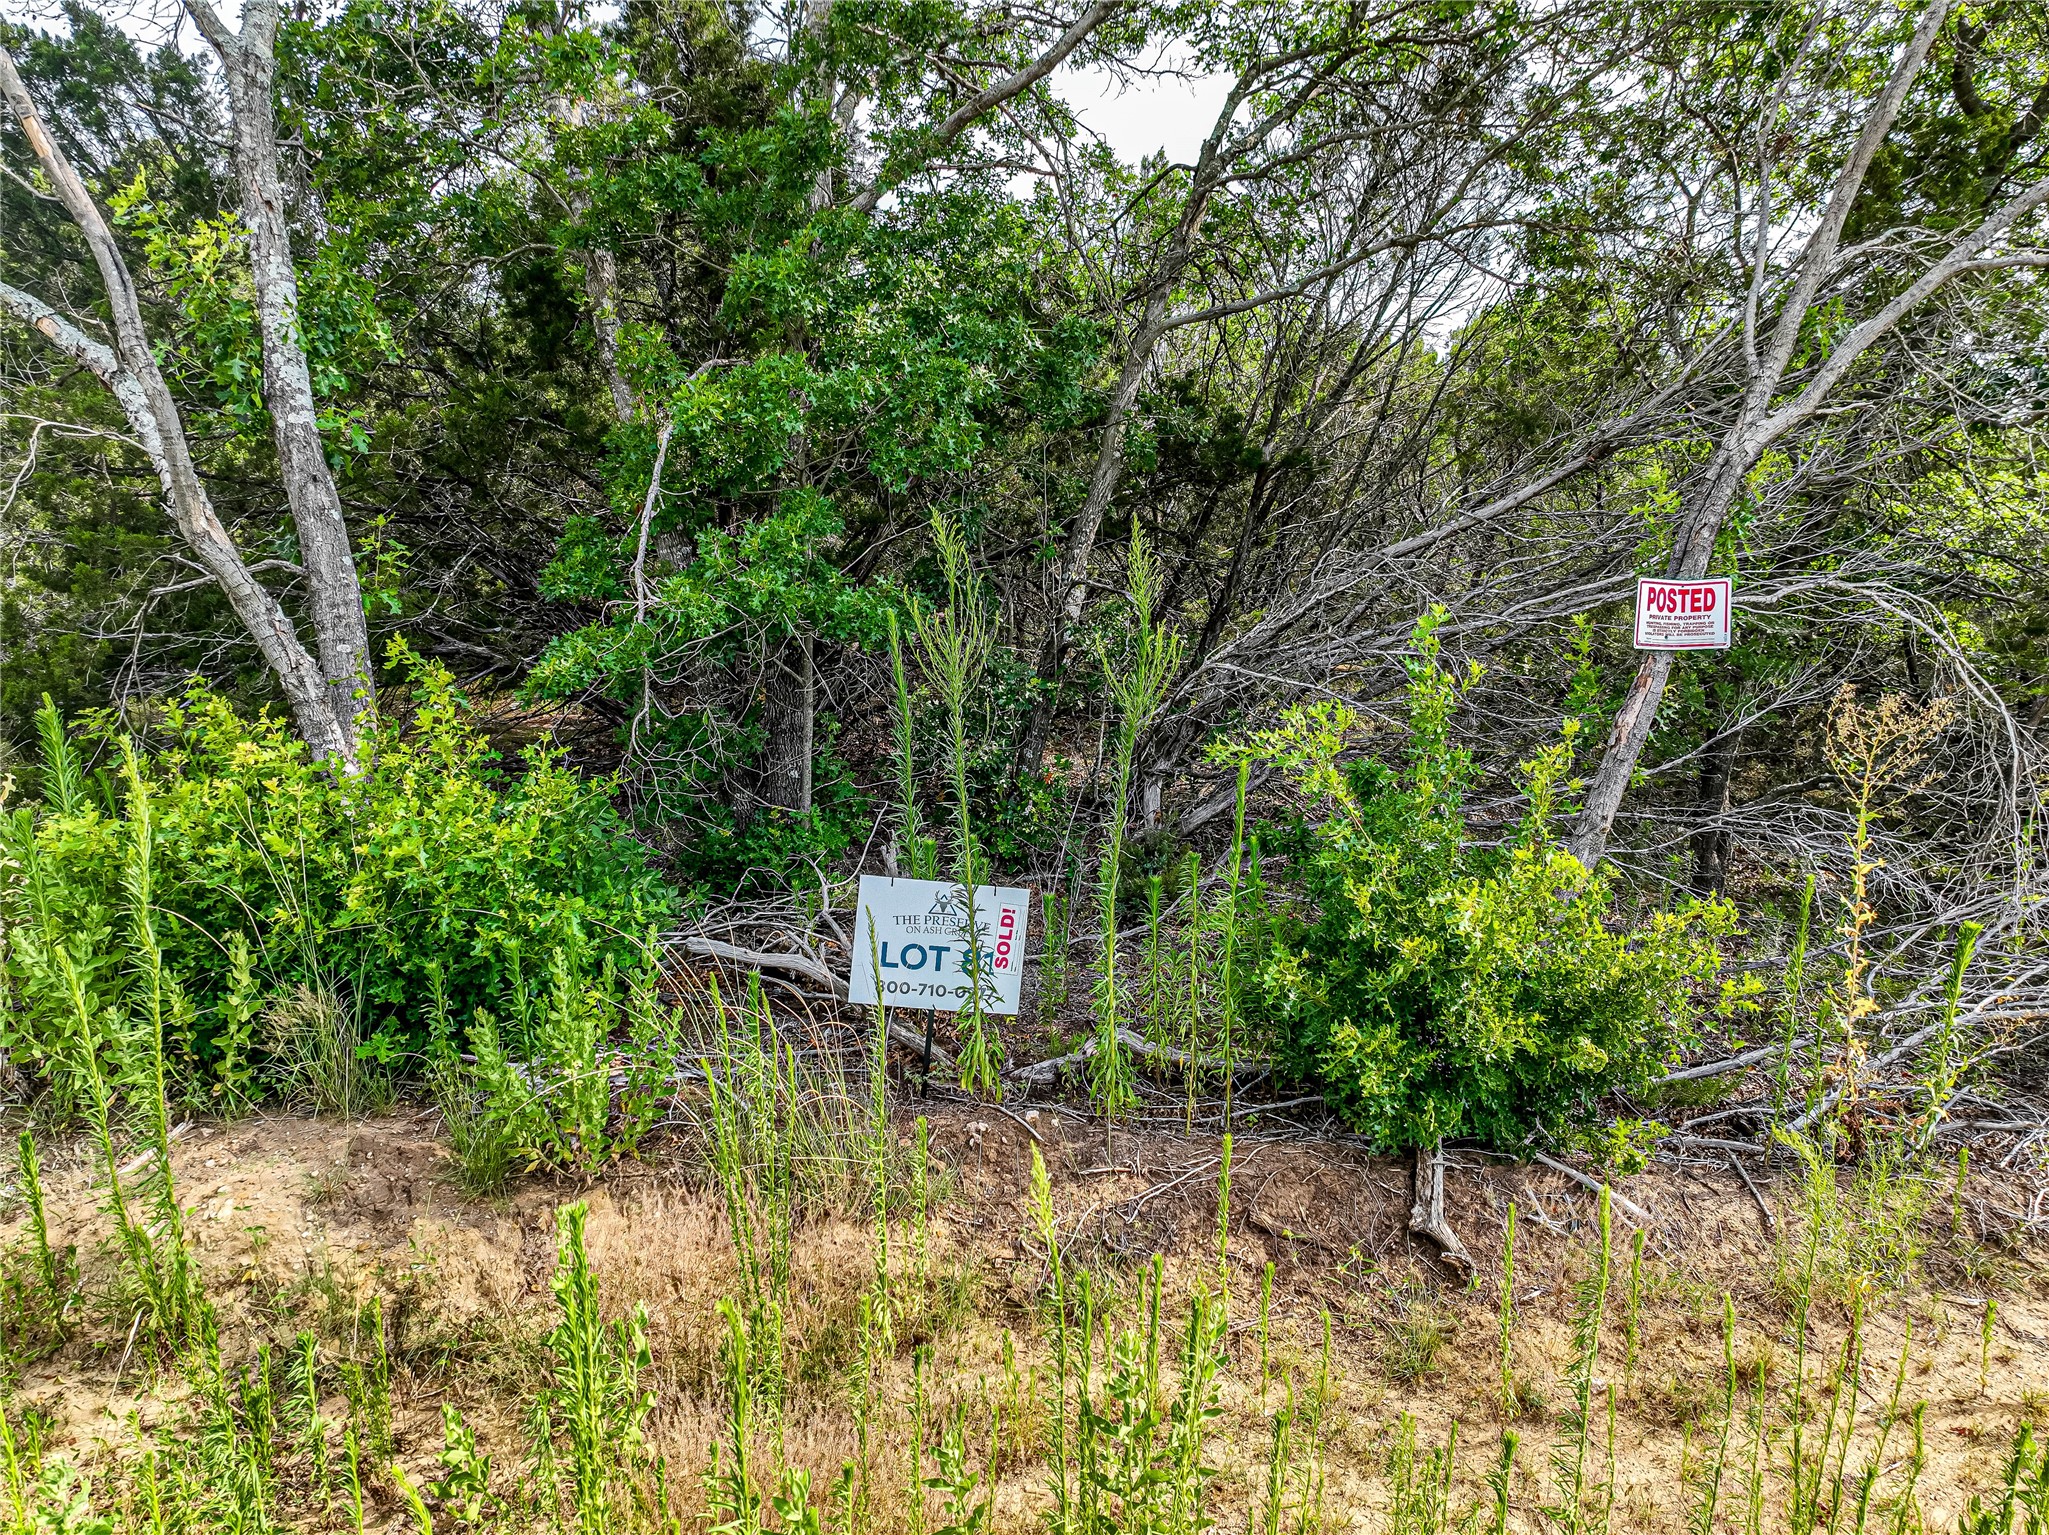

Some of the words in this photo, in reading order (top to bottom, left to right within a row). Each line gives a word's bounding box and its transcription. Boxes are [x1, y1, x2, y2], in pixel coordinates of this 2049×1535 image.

[1647, 587, 1716, 613] POSTED
[892, 914, 920, 925] THE
[922, 926, 942, 934] ASH
[994, 908, 1016, 969] SOLD!
[880, 942, 950, 972] LOT
